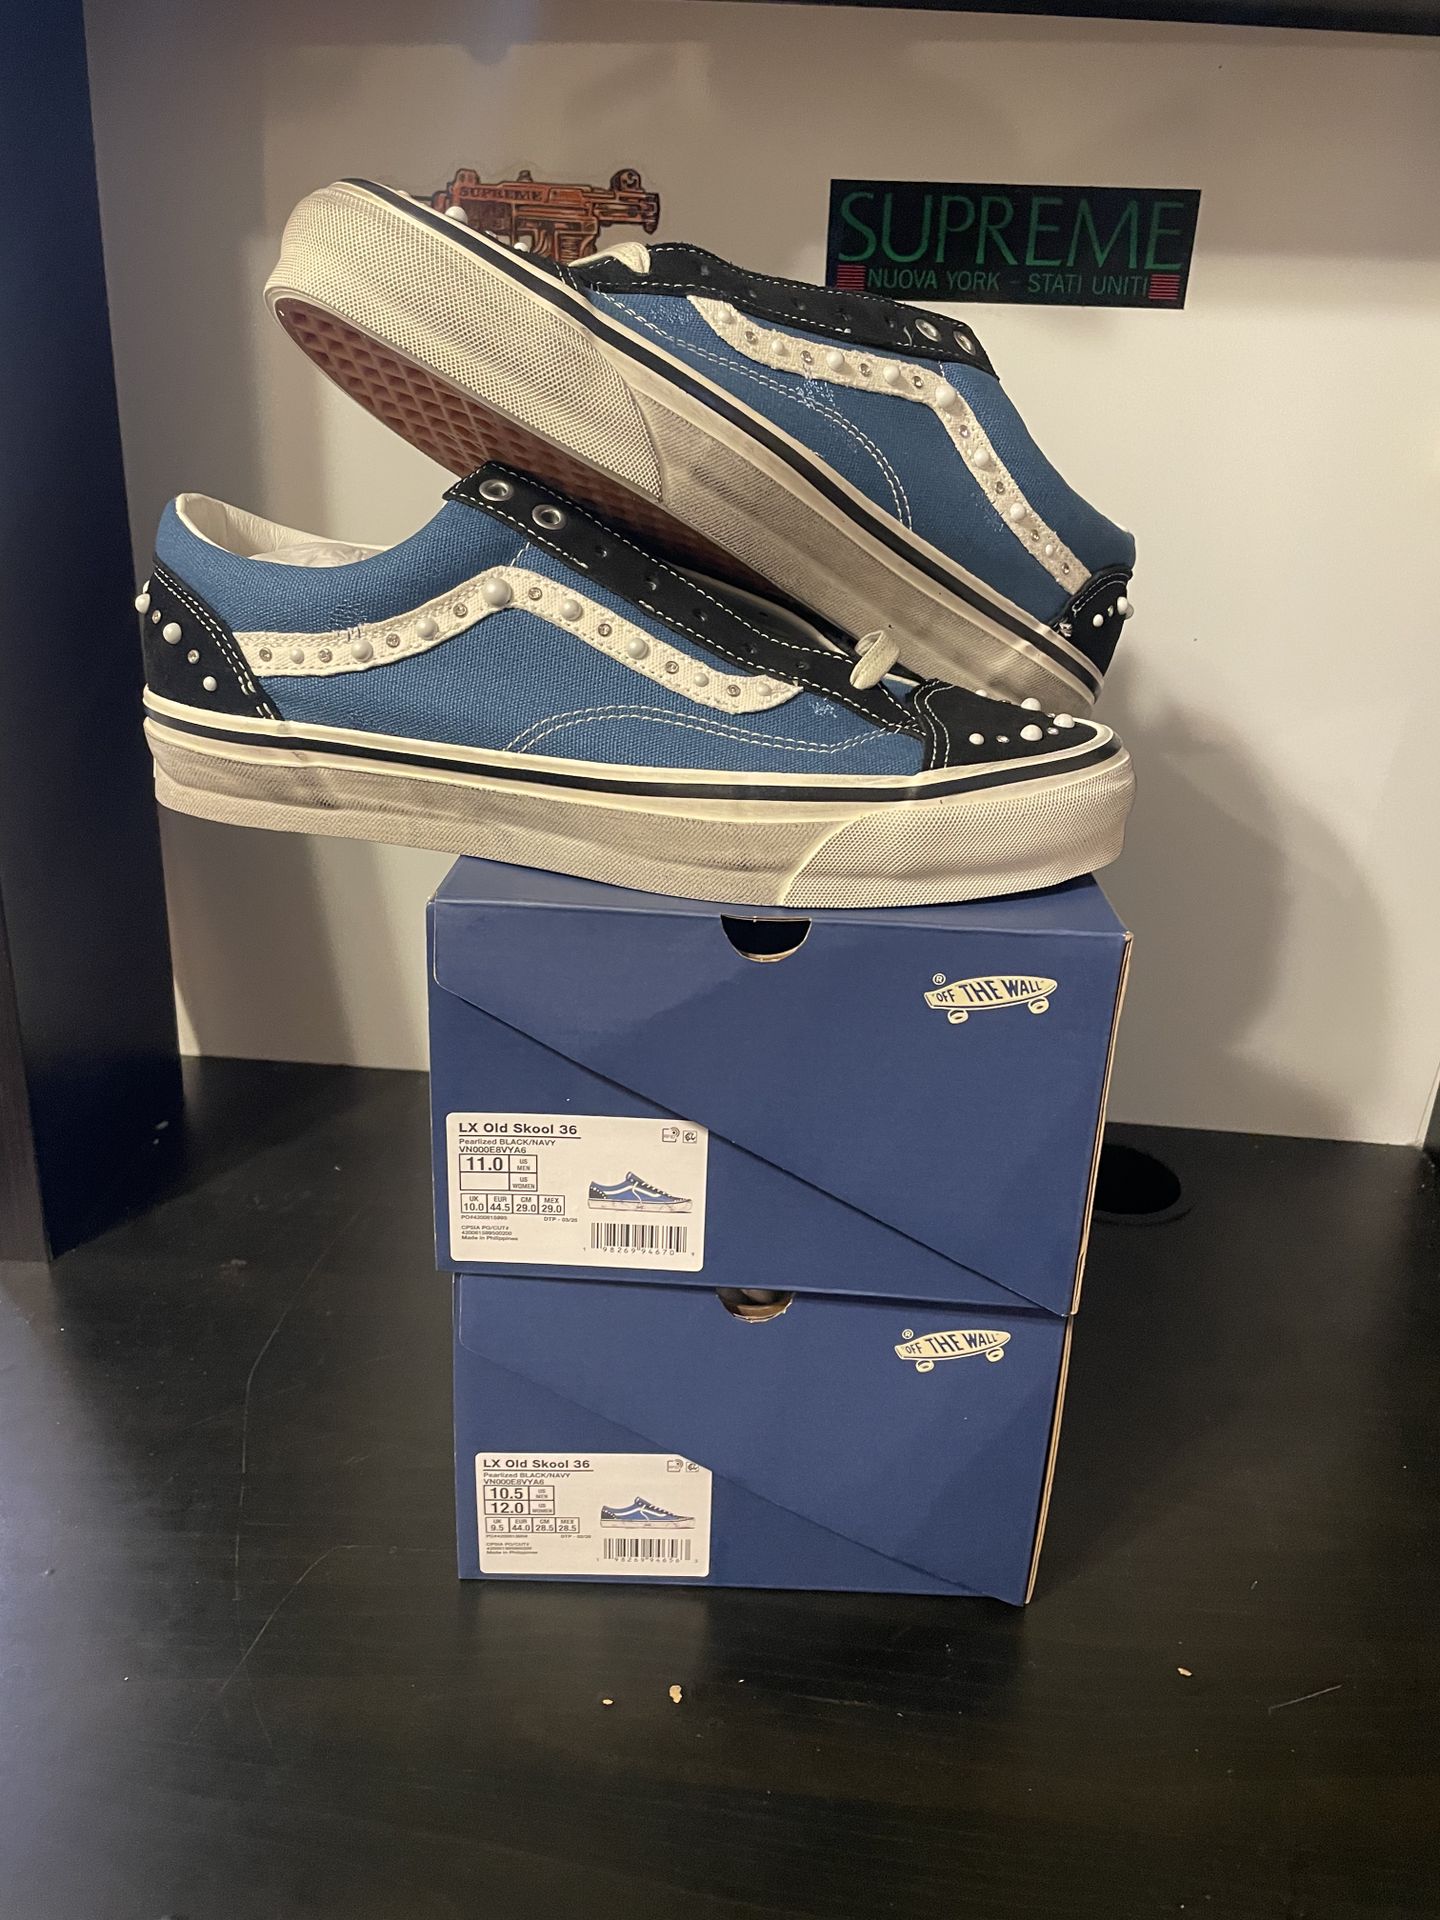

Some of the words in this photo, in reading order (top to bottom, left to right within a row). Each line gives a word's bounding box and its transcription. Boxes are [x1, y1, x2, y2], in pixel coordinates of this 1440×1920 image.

[460, 186, 544, 201] SUPREME
[838, 191, 1185, 271] SUPREME
[867, 268, 938, 290] NUOVA
[947, 270, 1001, 292] YORK
[1028, 272, 1082, 295] STATI
[1092, 275, 1149, 297] UNITI
[935, 988, 956, 1004] OFF
[958, 979, 1004, 1003] THE
[1001, 978, 1042, 999] WALL
[458, 1122, 478, 1133] LX
[483, 1122, 508, 1133] Old
[513, 1123, 554, 1134] Skool
[559, 1124, 577, 1135] 36
[458, 1138, 497, 1146] Pearlized
[499, 1138, 556, 1147] BLACK/NAVY
[466, 1156, 503, 1171] 11.0
[463, 1202, 485, 1212] 10.0
[489, 1203, 510, 1212] 44.5
[516, 1203, 537, 1213] 29.0
[541, 1204, 562, 1214] 29.0
[904, 1342, 923, 1355] OFF
[925, 1333, 965, 1355] THE
[961, 1332, 999, 1349] WALL
[483, 1459, 501, 1468] LX
[505, 1459, 528, 1468] Old
[532, 1459, 569, 1469] Skool
[573, 1460, 590, 1469] 36
[490, 1487, 523, 1499] 10.5
[490, 1502, 524, 1514] 12.0
[490, 1524, 504, 1532] 9.5
[511, 1524, 531, 1532] 44.0
